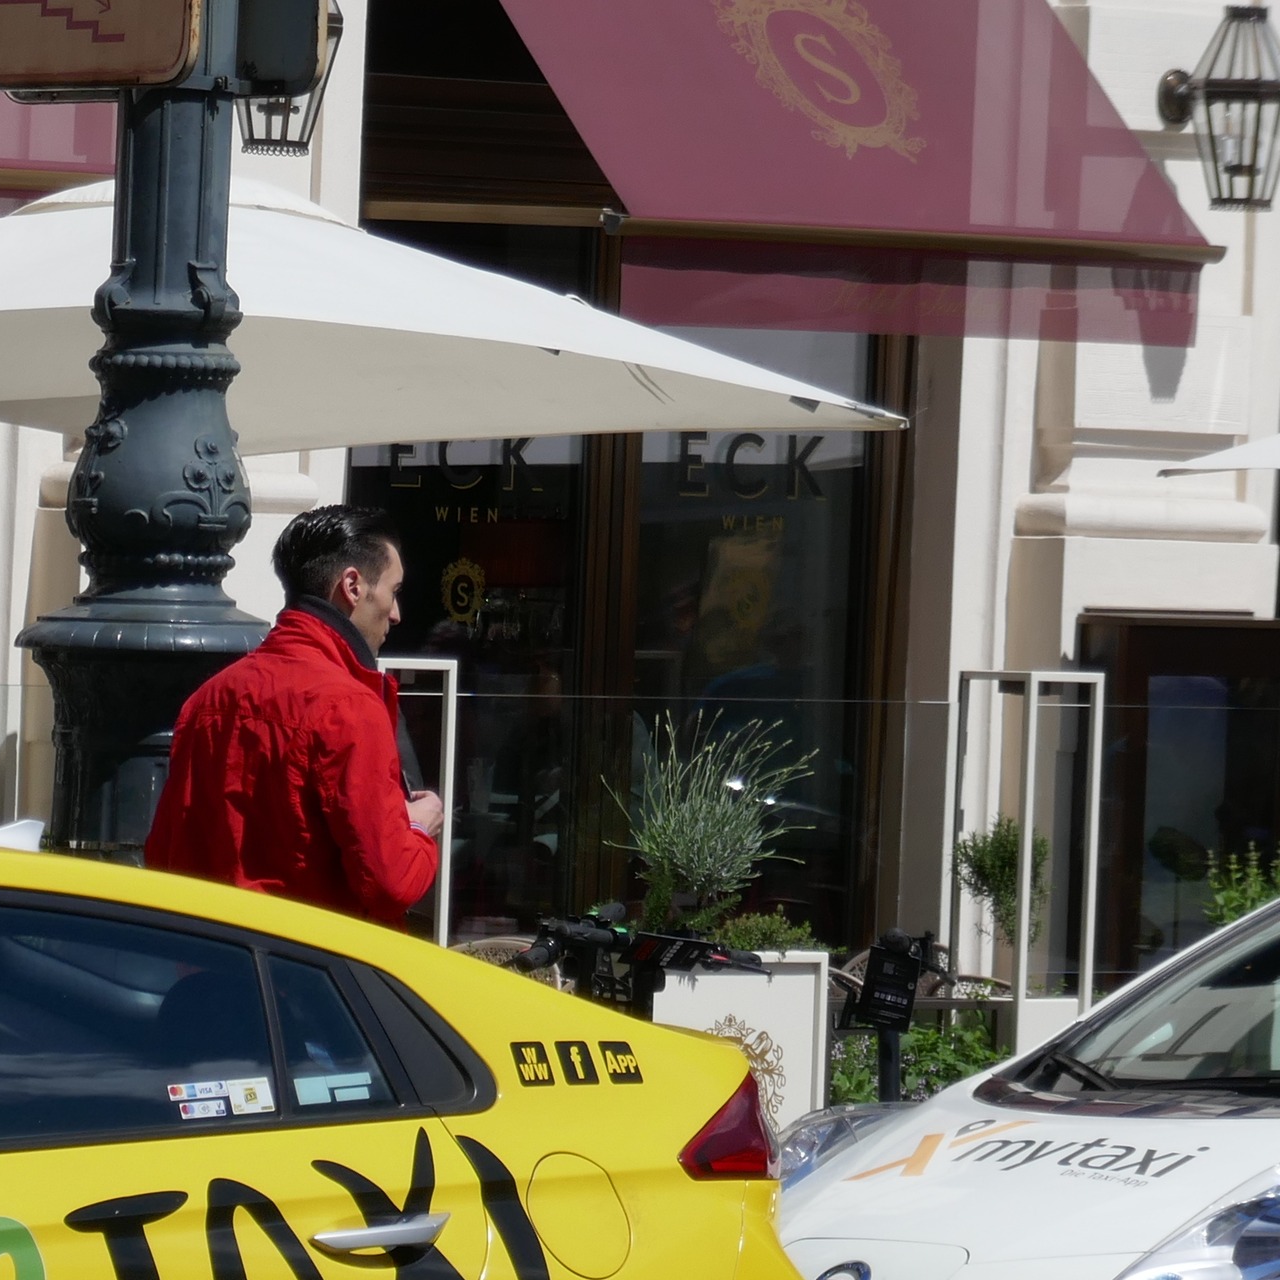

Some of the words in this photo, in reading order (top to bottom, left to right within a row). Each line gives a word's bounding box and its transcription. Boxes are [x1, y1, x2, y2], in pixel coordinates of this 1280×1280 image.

[792, 31, 862, 107] S
[390, 436, 544, 492] ECK
[678, 431, 828, 500] ECK
[435, 506, 499, 524] WIEN
[722, 514, 785, 531] WIEN
[456, 582, 468, 607] S
[951, 1137, 1211, 1179] mytaxi
[1060, 1168, 1086, 1178] Die
